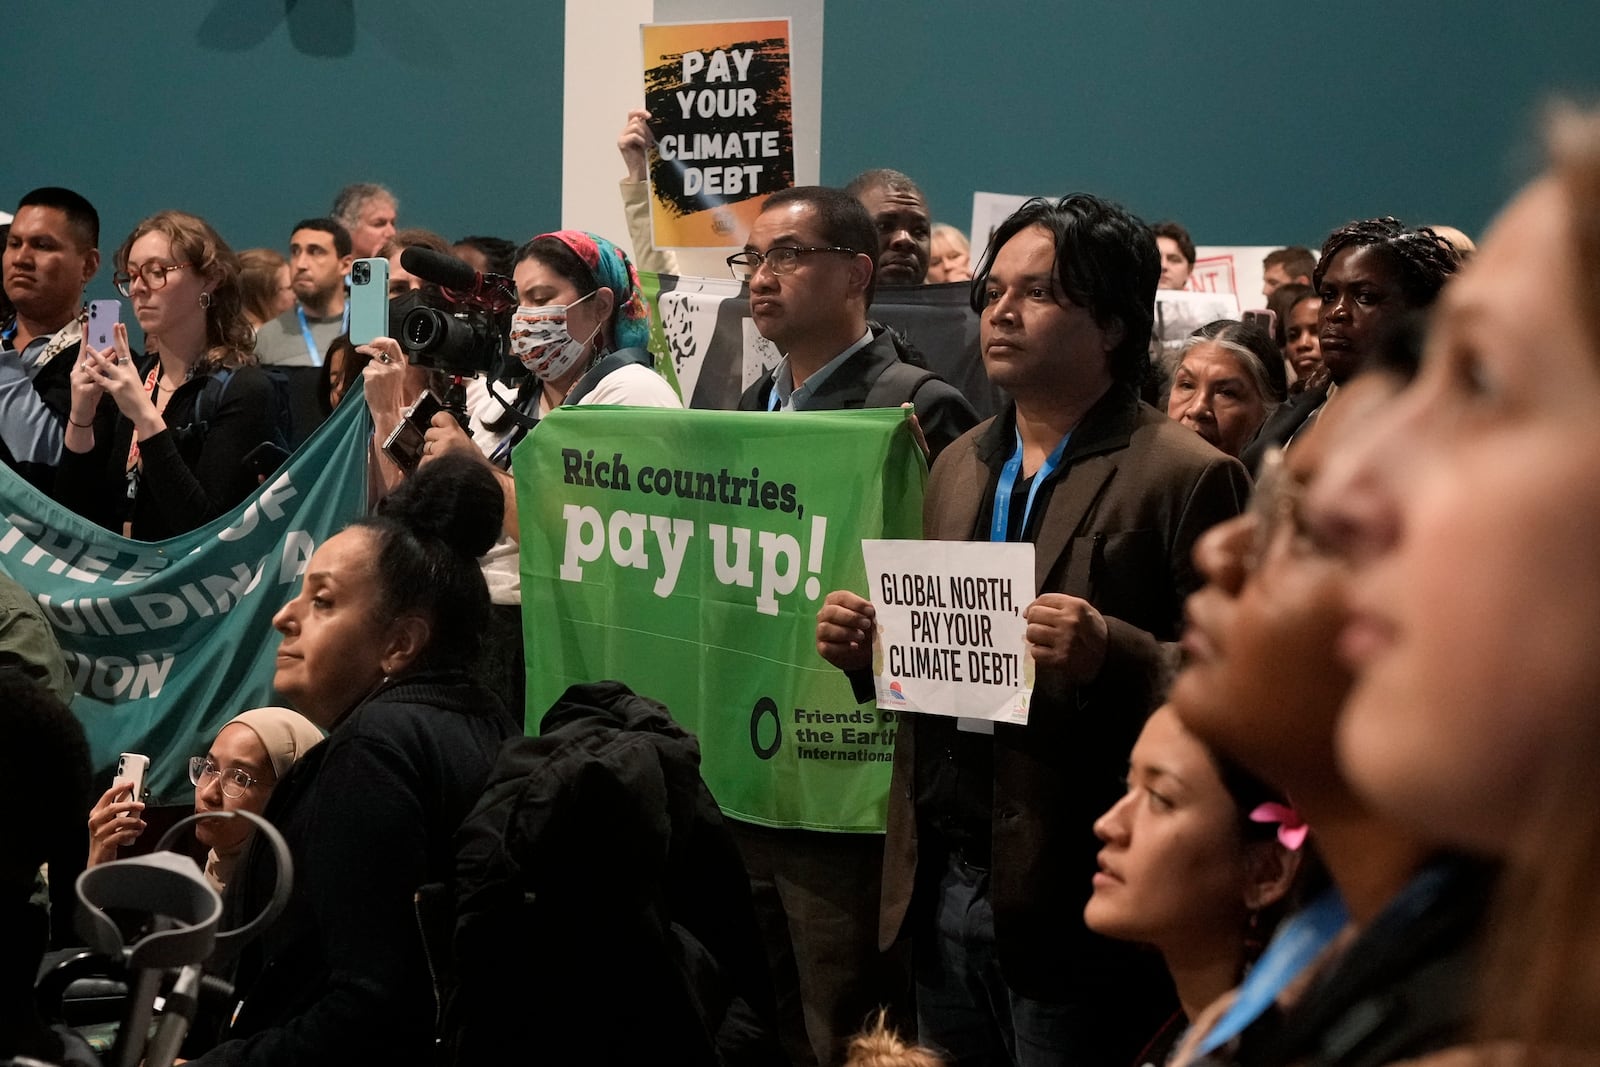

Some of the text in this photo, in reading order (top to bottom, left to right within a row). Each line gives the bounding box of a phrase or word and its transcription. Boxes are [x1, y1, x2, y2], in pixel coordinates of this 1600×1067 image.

[682, 48, 754, 84] PAY
[676, 88, 757, 119] YOUR
[659, 130, 779, 161] CLIMATE
[683, 164, 764, 197] DEBT
[561, 448, 804, 520] Rich countries,
[559, 504, 828, 616] pay up!
[881, 573, 1019, 617] GLOBAL NORTH,
[911, 610, 993, 648] PAY YOUR
[889, 645, 1018, 688] CLIMATE DEBT!
[794, 708, 875, 724] Friends
[795, 728, 834, 743] the
